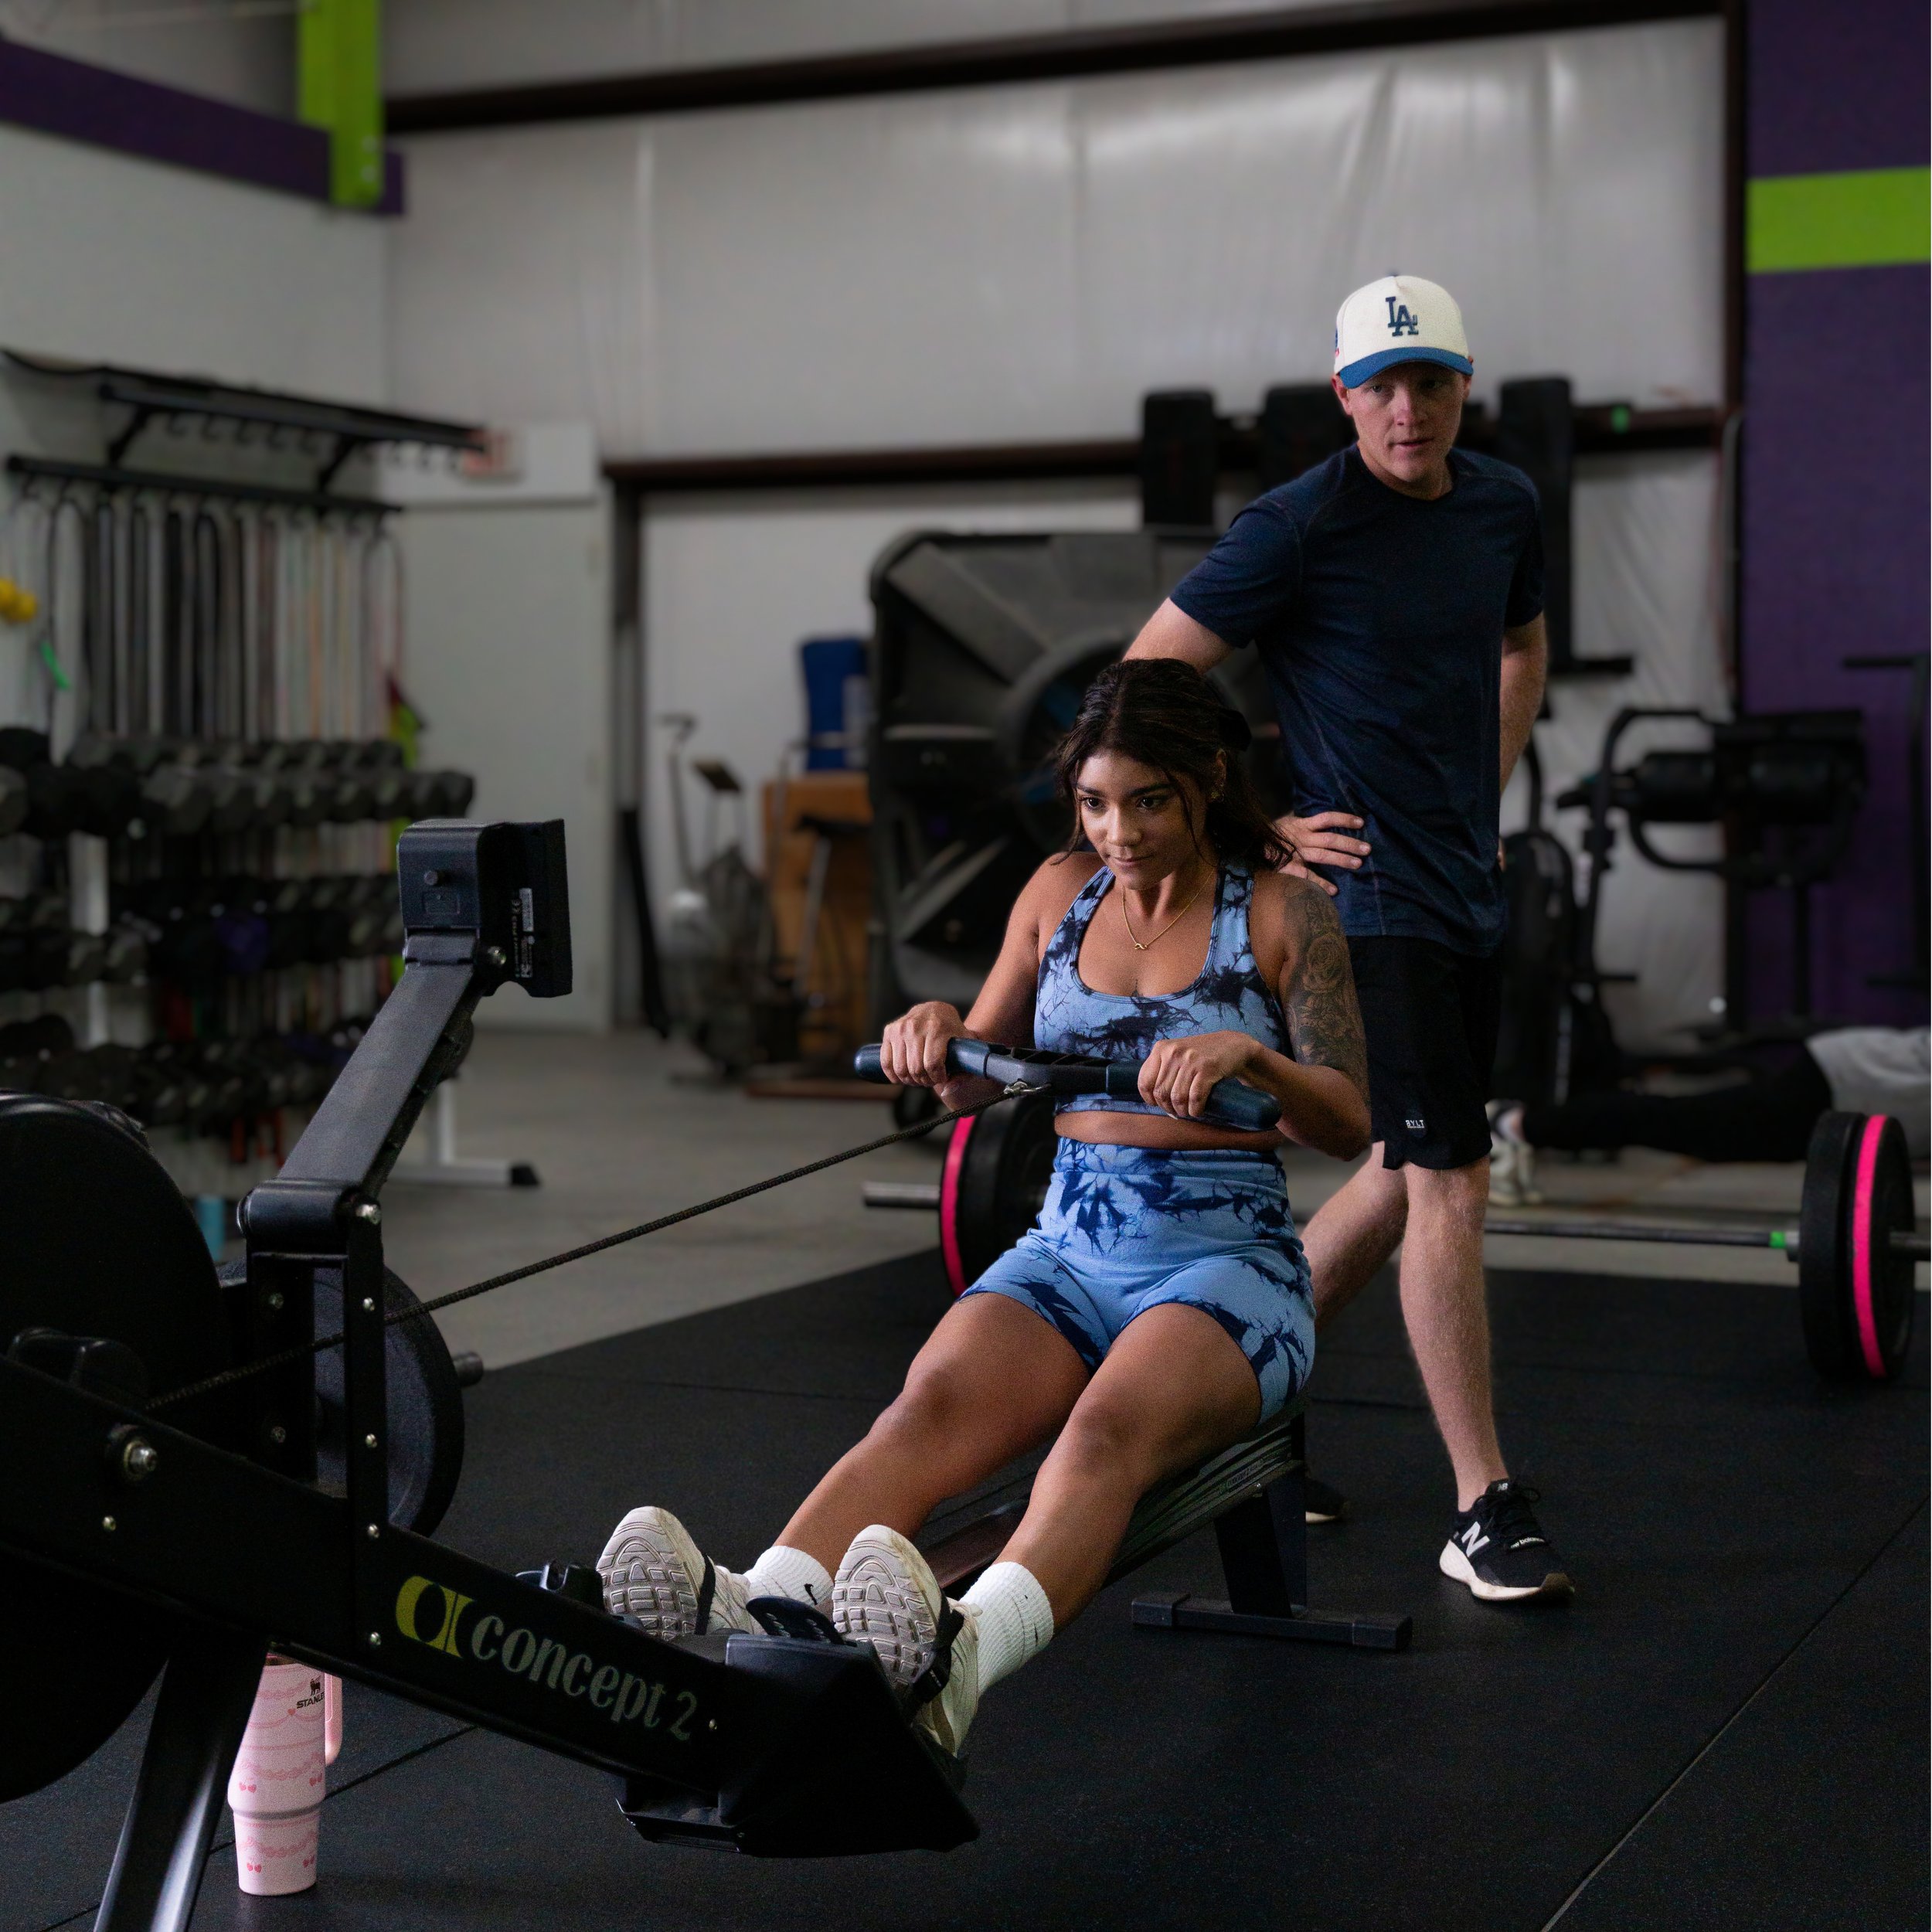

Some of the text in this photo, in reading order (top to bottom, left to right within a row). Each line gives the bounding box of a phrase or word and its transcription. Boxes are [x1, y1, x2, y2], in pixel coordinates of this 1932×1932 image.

[1385, 296, 1419, 337] LA
[1461, 1520, 1491, 1558] N
[471, 1614, 697, 1741] concept 2
[296, 1690, 325, 1709] STANLE
